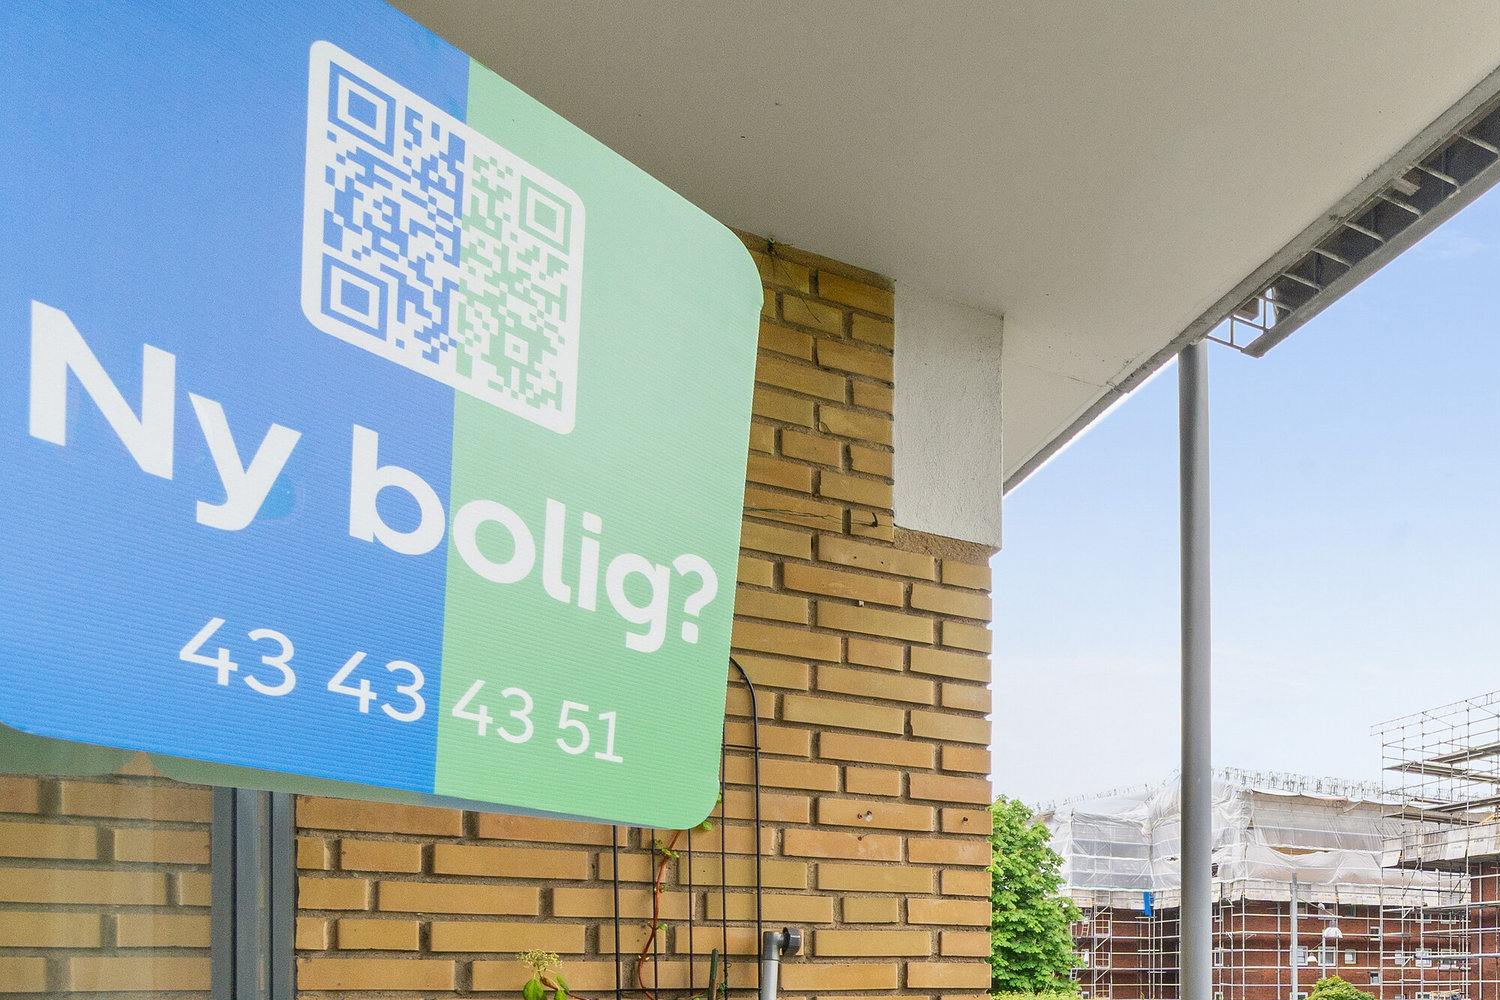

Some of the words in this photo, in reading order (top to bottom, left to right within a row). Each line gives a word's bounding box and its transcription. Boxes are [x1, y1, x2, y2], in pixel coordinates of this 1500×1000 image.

[29, 300, 302, 531] Ny
[349, 424, 719, 653] bolig?
[179, 617, 296, 697] 43
[327, 651, 426, 722] 43
[452, 679, 534, 744] 43
[556, 699, 624, 763] 51
